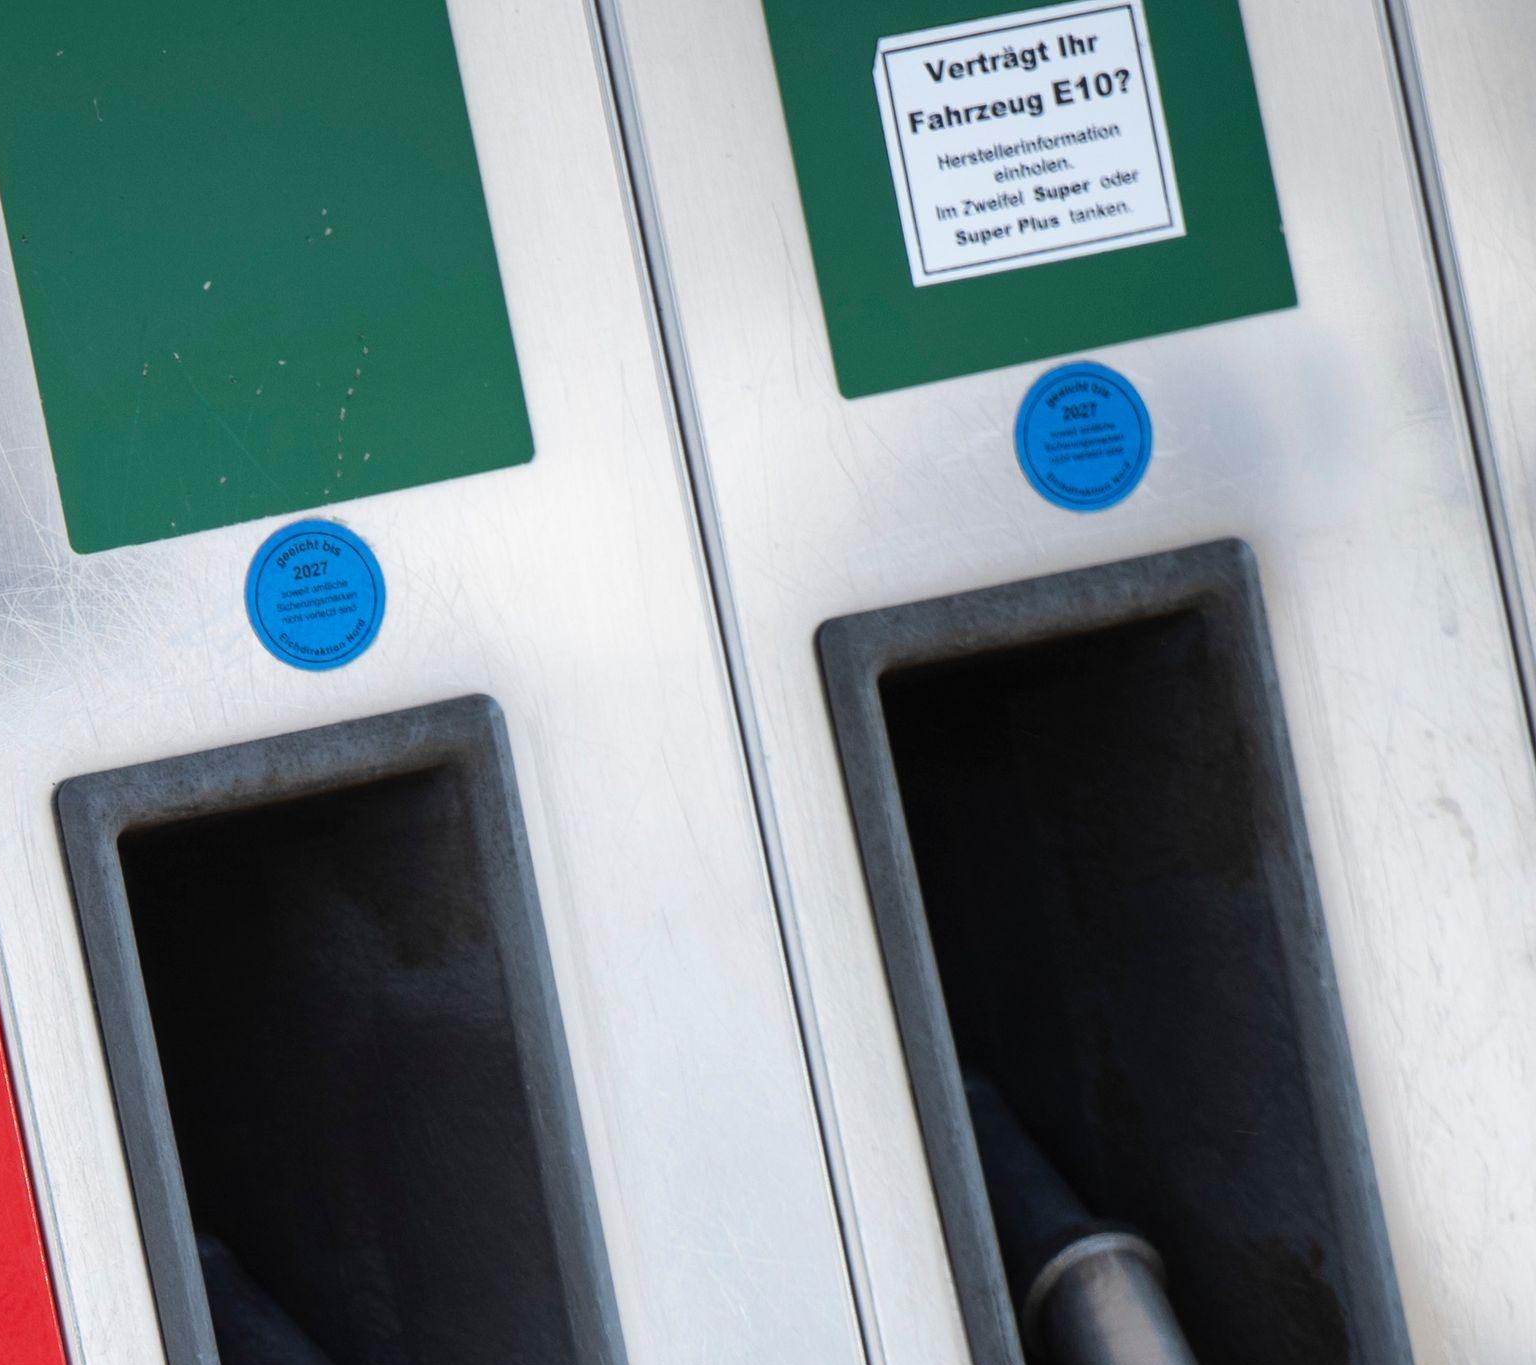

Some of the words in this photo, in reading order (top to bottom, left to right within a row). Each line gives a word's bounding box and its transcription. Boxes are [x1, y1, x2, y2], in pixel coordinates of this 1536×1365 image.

[925, 40, 1050, 83] Verträgt
[1057, 32, 1099, 58] Ihr
[908, 91, 1045, 134] Fahrzeug
[1053, 68, 1130, 106] E10?
[937, 122, 1121, 171] Herstellerinformation
[994, 156, 1074, 184] einholen.
[962, 190, 1025, 216] Zweifel
[1033, 178, 1092, 205] Super
[1100, 169, 1139, 191] oder
[955, 225, 1013, 249] Super
[1019, 216, 1060, 236] Plus
[1070, 202, 1134, 226] tanken.
[293, 561, 328, 580] 2027
